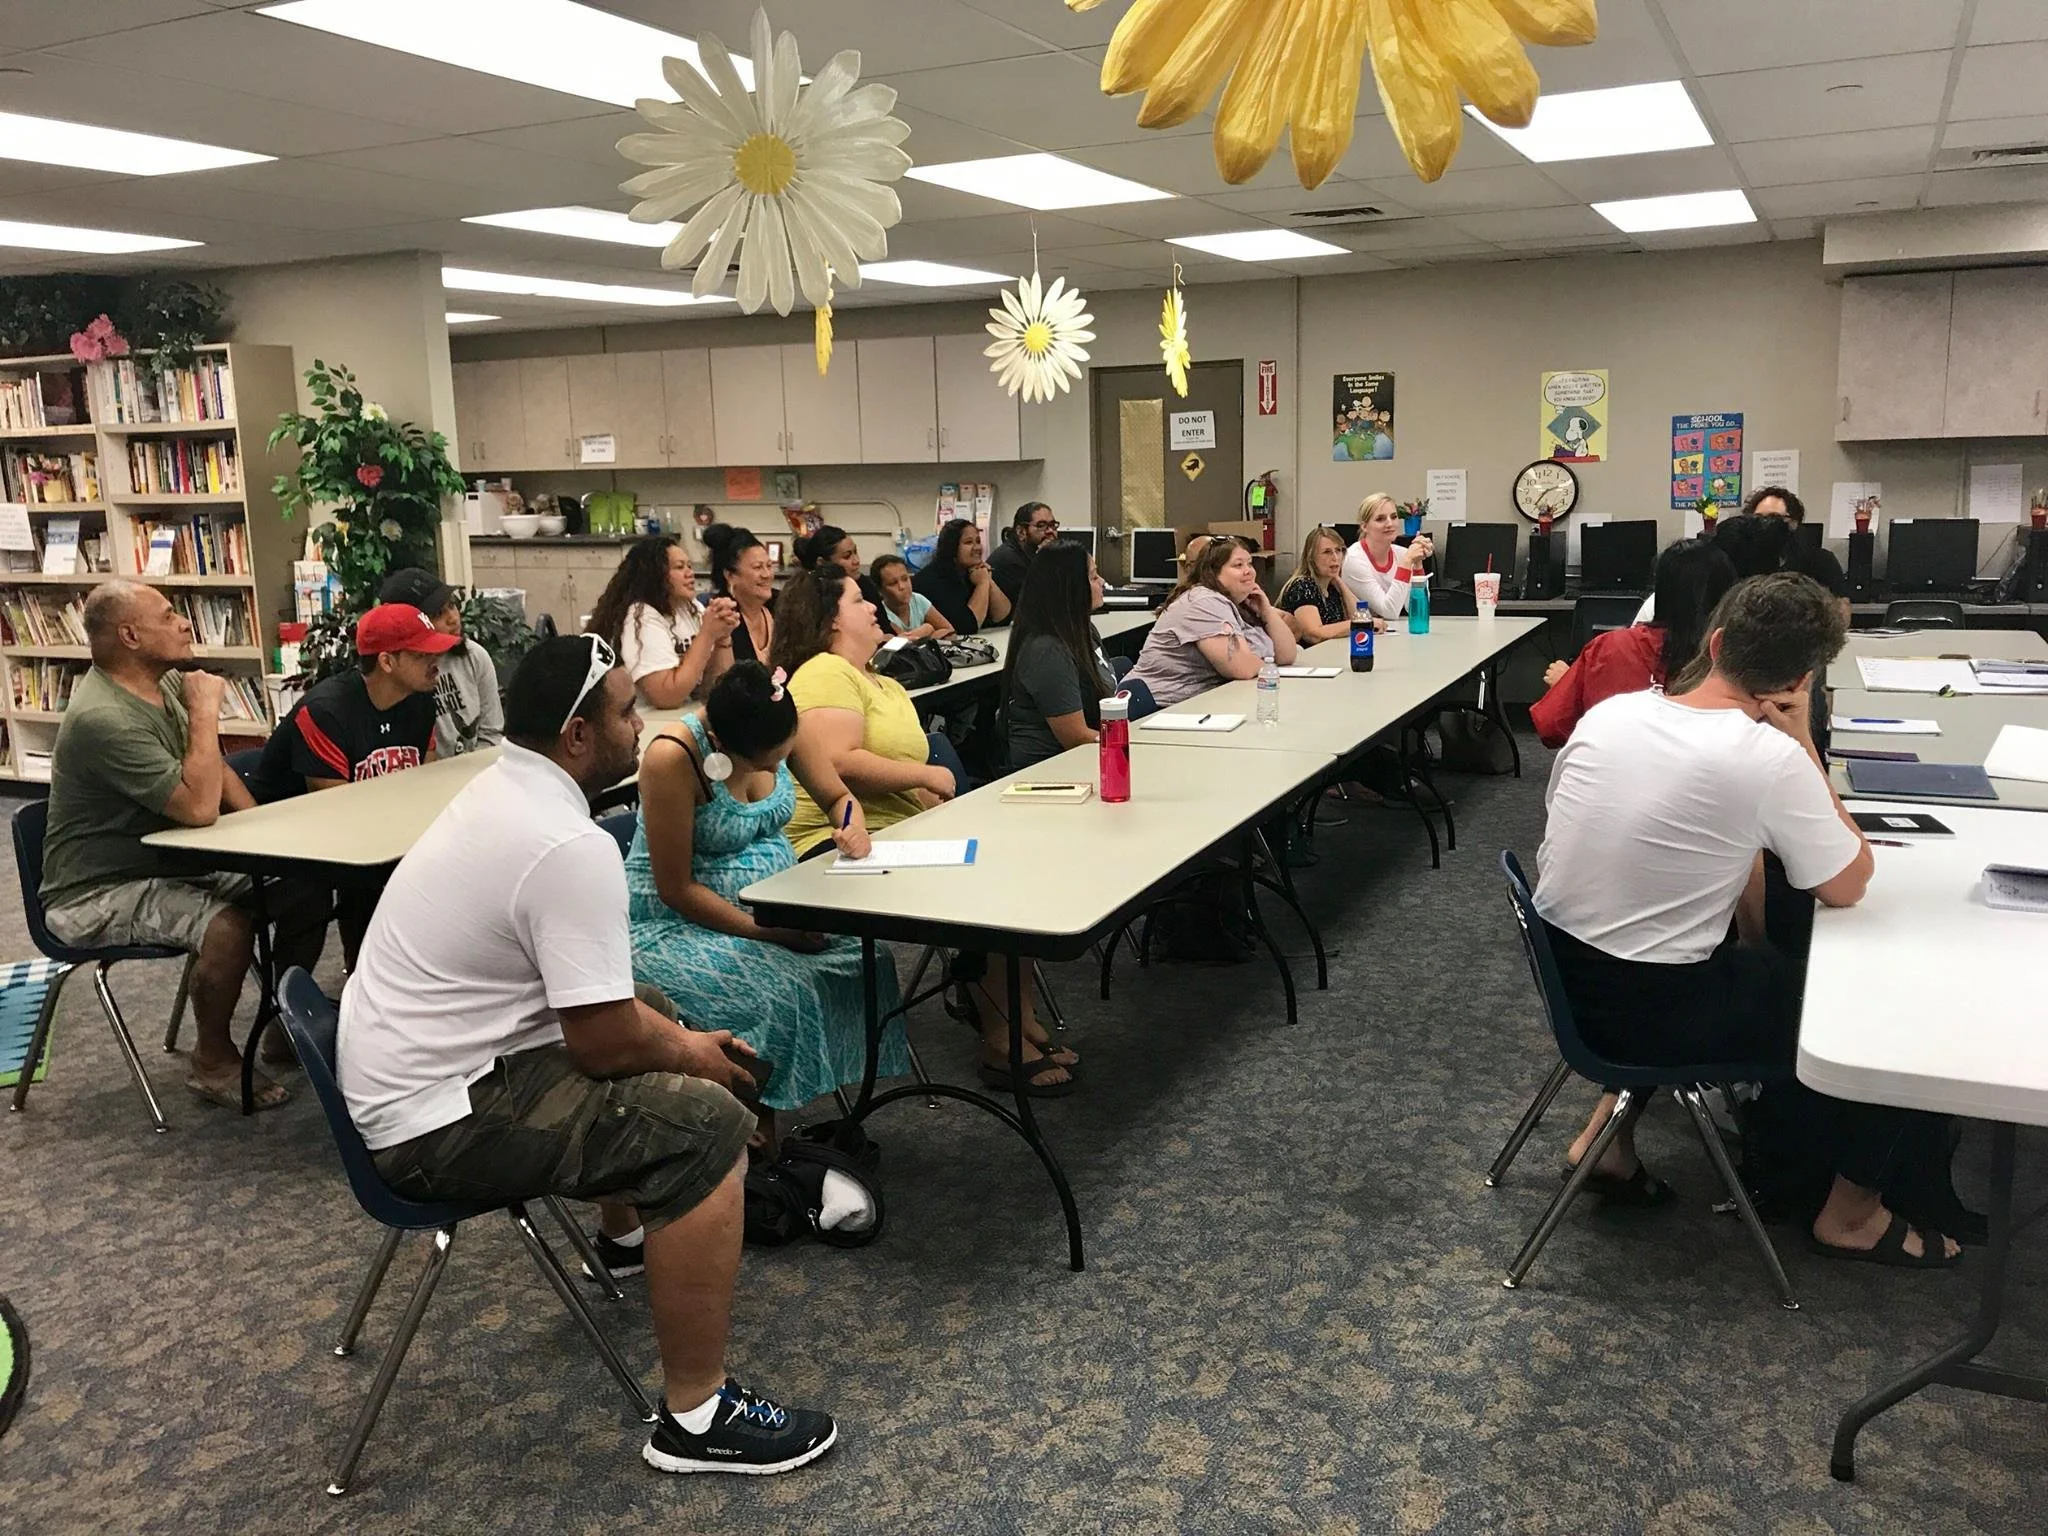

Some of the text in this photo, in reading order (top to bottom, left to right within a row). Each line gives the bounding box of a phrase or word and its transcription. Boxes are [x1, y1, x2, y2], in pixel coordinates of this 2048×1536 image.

[1178, 415, 1207, 425] DO NOT
[1690, 414, 1725, 424] SCHOOL
[1181, 428, 1206, 437] ENTER
[1543, 469, 1552, 477] 12
[706, 1447, 733, 1455] speedo
